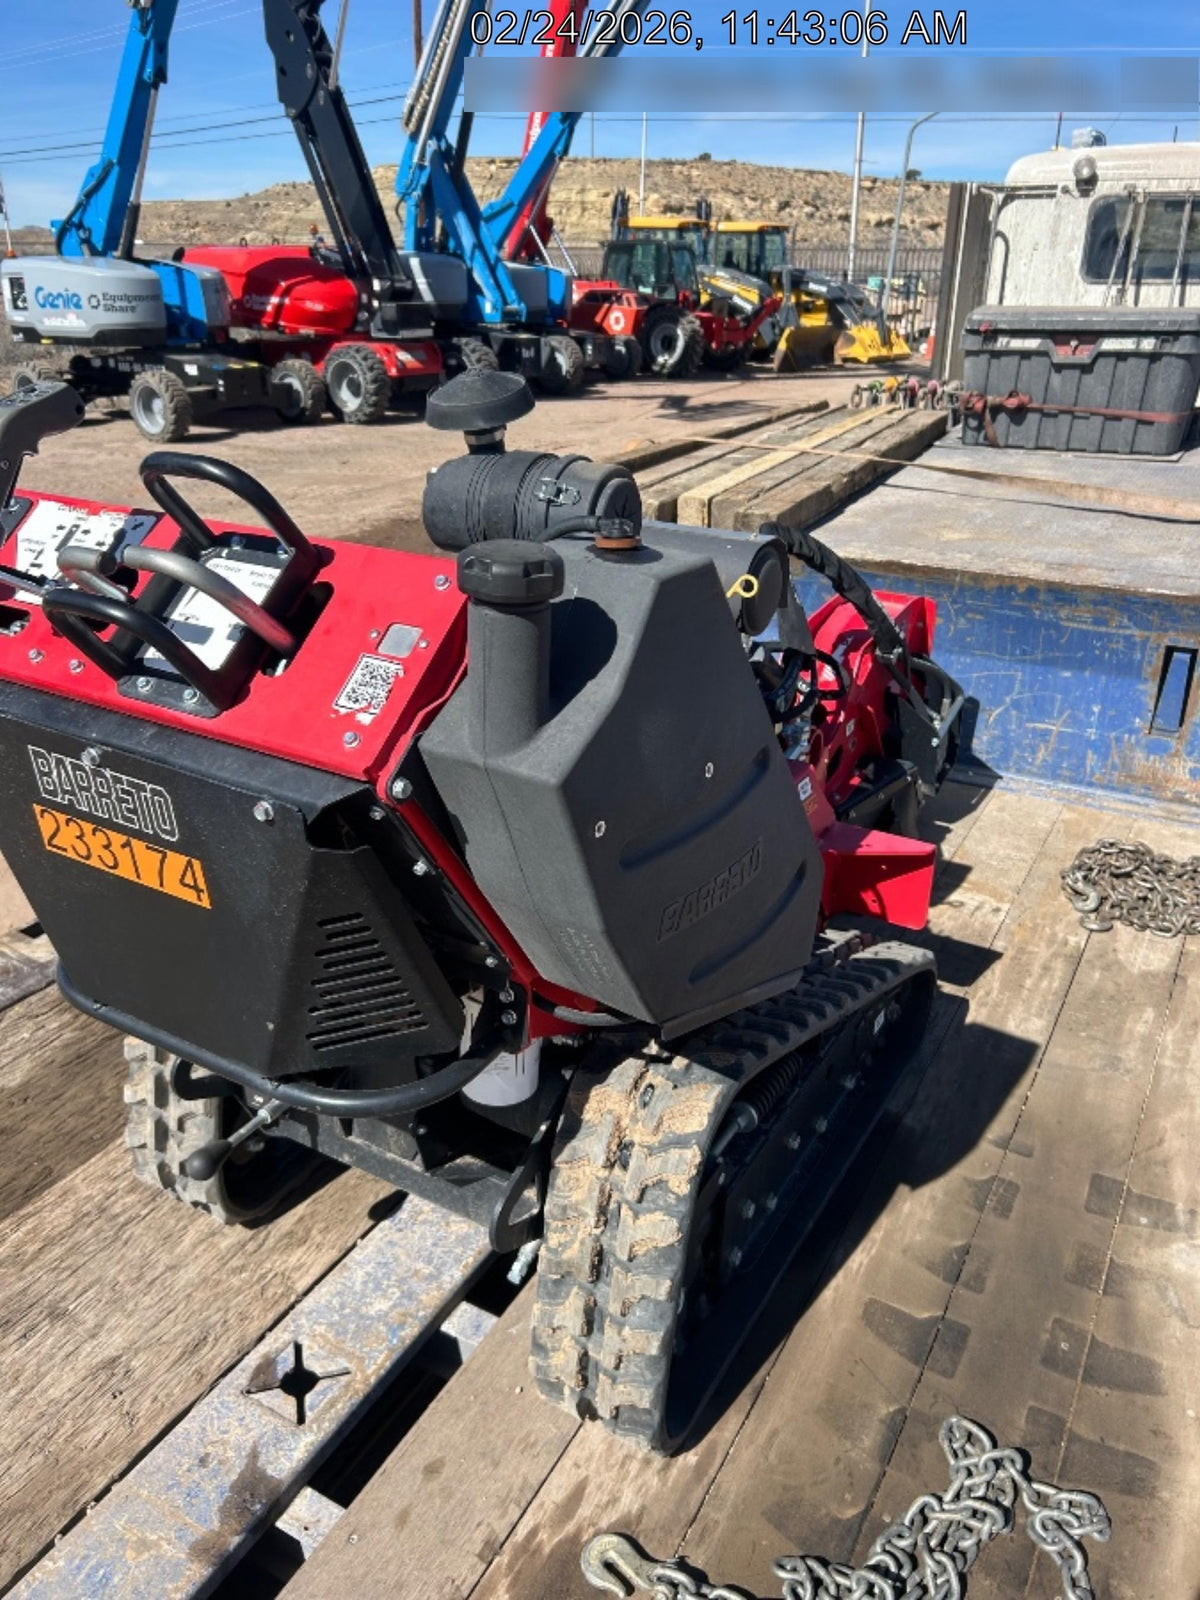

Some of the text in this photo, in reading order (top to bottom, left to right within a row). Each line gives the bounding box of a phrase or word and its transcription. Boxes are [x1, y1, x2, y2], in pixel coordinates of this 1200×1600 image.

[35, 286, 83, 310] Genie
[102, 303, 137, 313] Share
[28, 745, 179, 842] BARRETO
[40, 809, 204, 902] 233174
[657, 838, 763, 944] BARRETO
